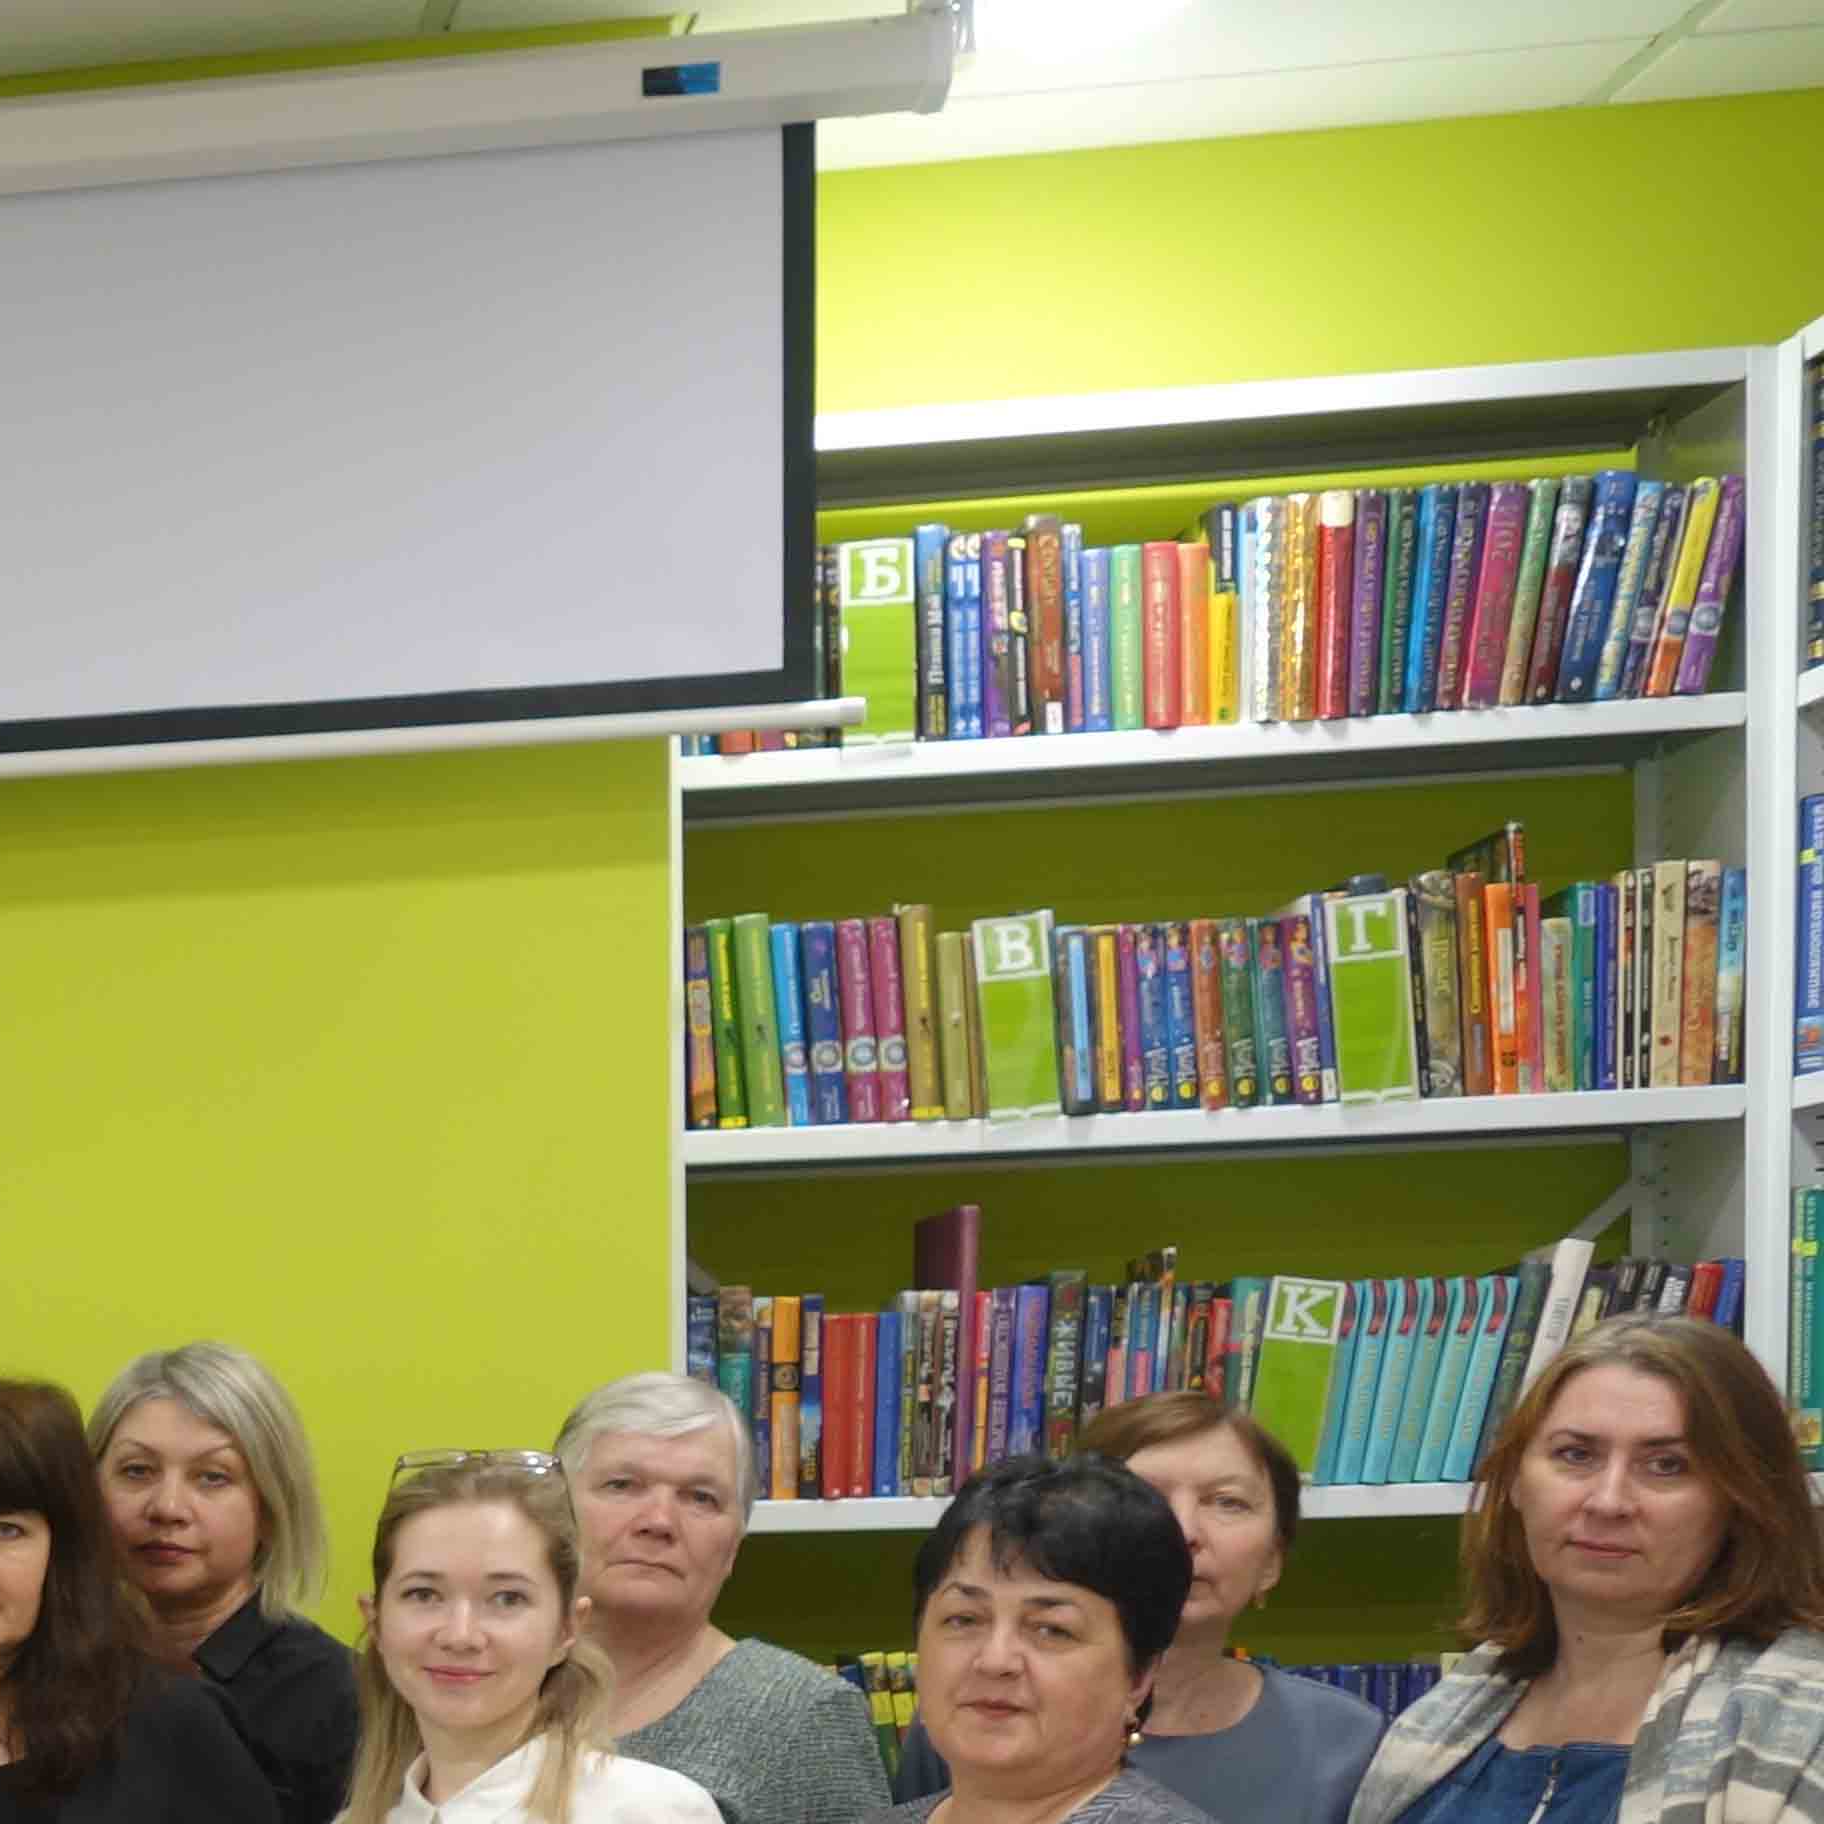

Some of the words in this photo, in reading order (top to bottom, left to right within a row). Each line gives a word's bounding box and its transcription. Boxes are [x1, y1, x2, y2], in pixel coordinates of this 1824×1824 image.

[862, 548, 901, 598] Б
[998, 925, 1034, 972] В
[1348, 902, 1388, 953] Г
[1282, 1286, 1331, 1335] К
